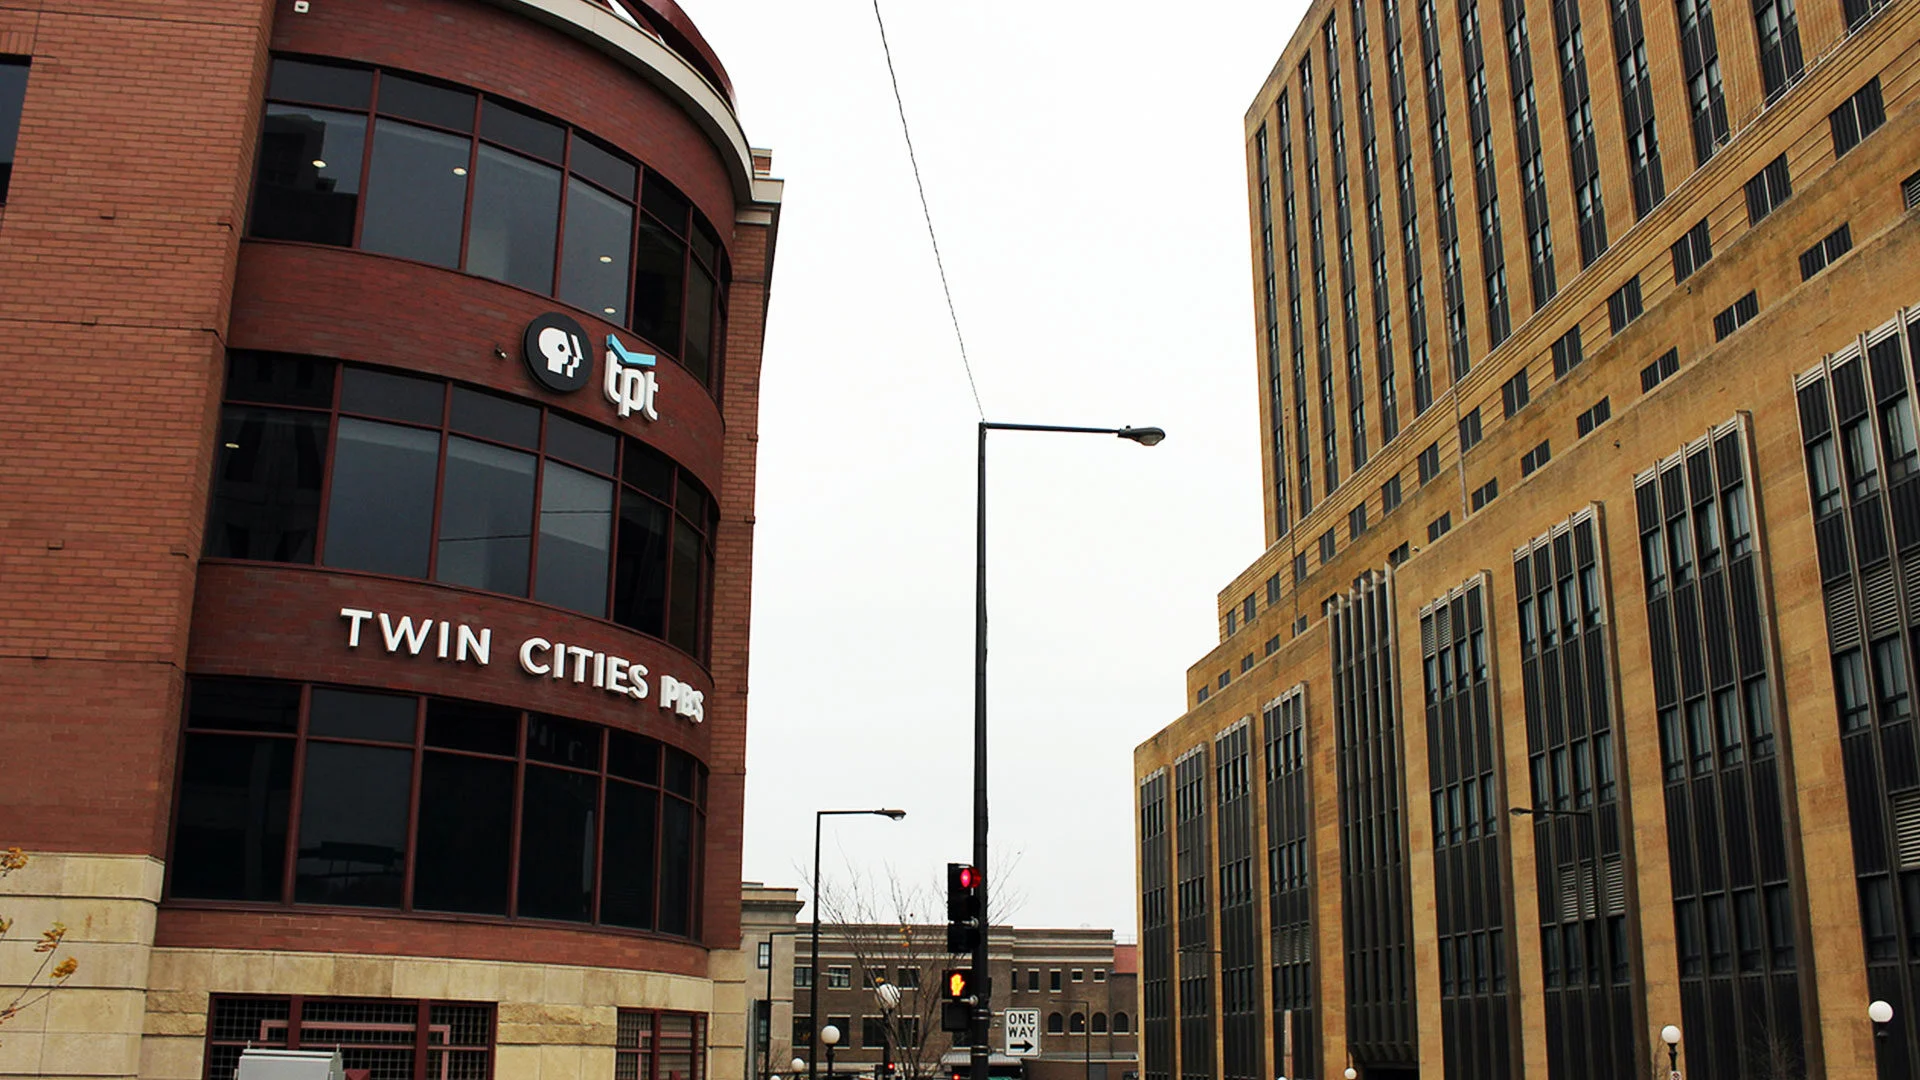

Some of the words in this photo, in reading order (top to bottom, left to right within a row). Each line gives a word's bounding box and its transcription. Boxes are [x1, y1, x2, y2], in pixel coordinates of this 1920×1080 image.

[604, 350, 659, 421] tpt
[340, 607, 491, 665] TWIN
[519, 637, 649, 700] CITIES
[659, 674, 704, 723] PBS
[1008, 1012, 1036, 1025] ONE
[1008, 1026, 1036, 1038] WAY
